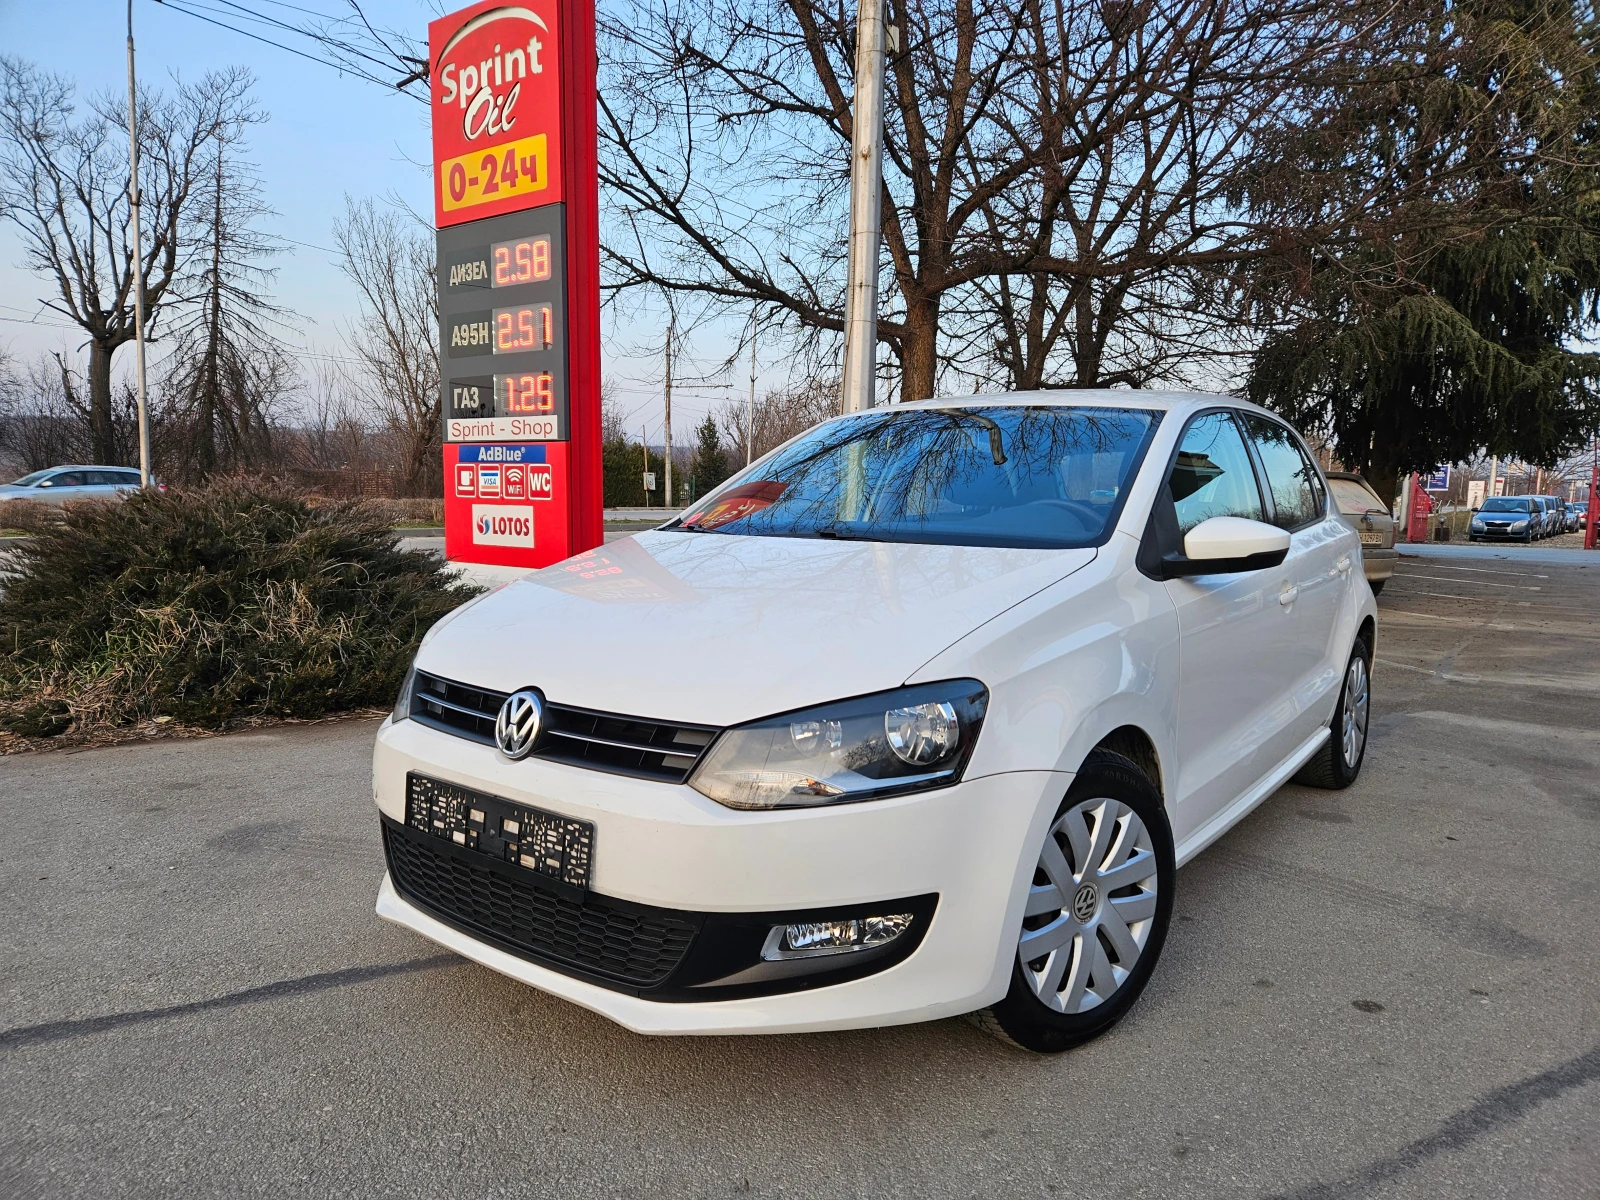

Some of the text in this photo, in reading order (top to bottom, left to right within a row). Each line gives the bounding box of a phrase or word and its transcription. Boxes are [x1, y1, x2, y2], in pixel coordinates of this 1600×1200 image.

[440, 35, 543, 109] Sprint
[463, 81, 521, 141] Oil
[449, 240, 549, 287] ДИЗЕЛ 2.58
[451, 307, 552, 349] А95Н 2.51
[453, 375, 553, 412] ГАЗ 1.25
[451, 421, 495, 440] Sprint
[511, 420, 553, 439] Shop
[507, 485, 523, 494] WiFi
[529, 473, 551, 491] WC
[492, 516, 530, 536] LOTOS
